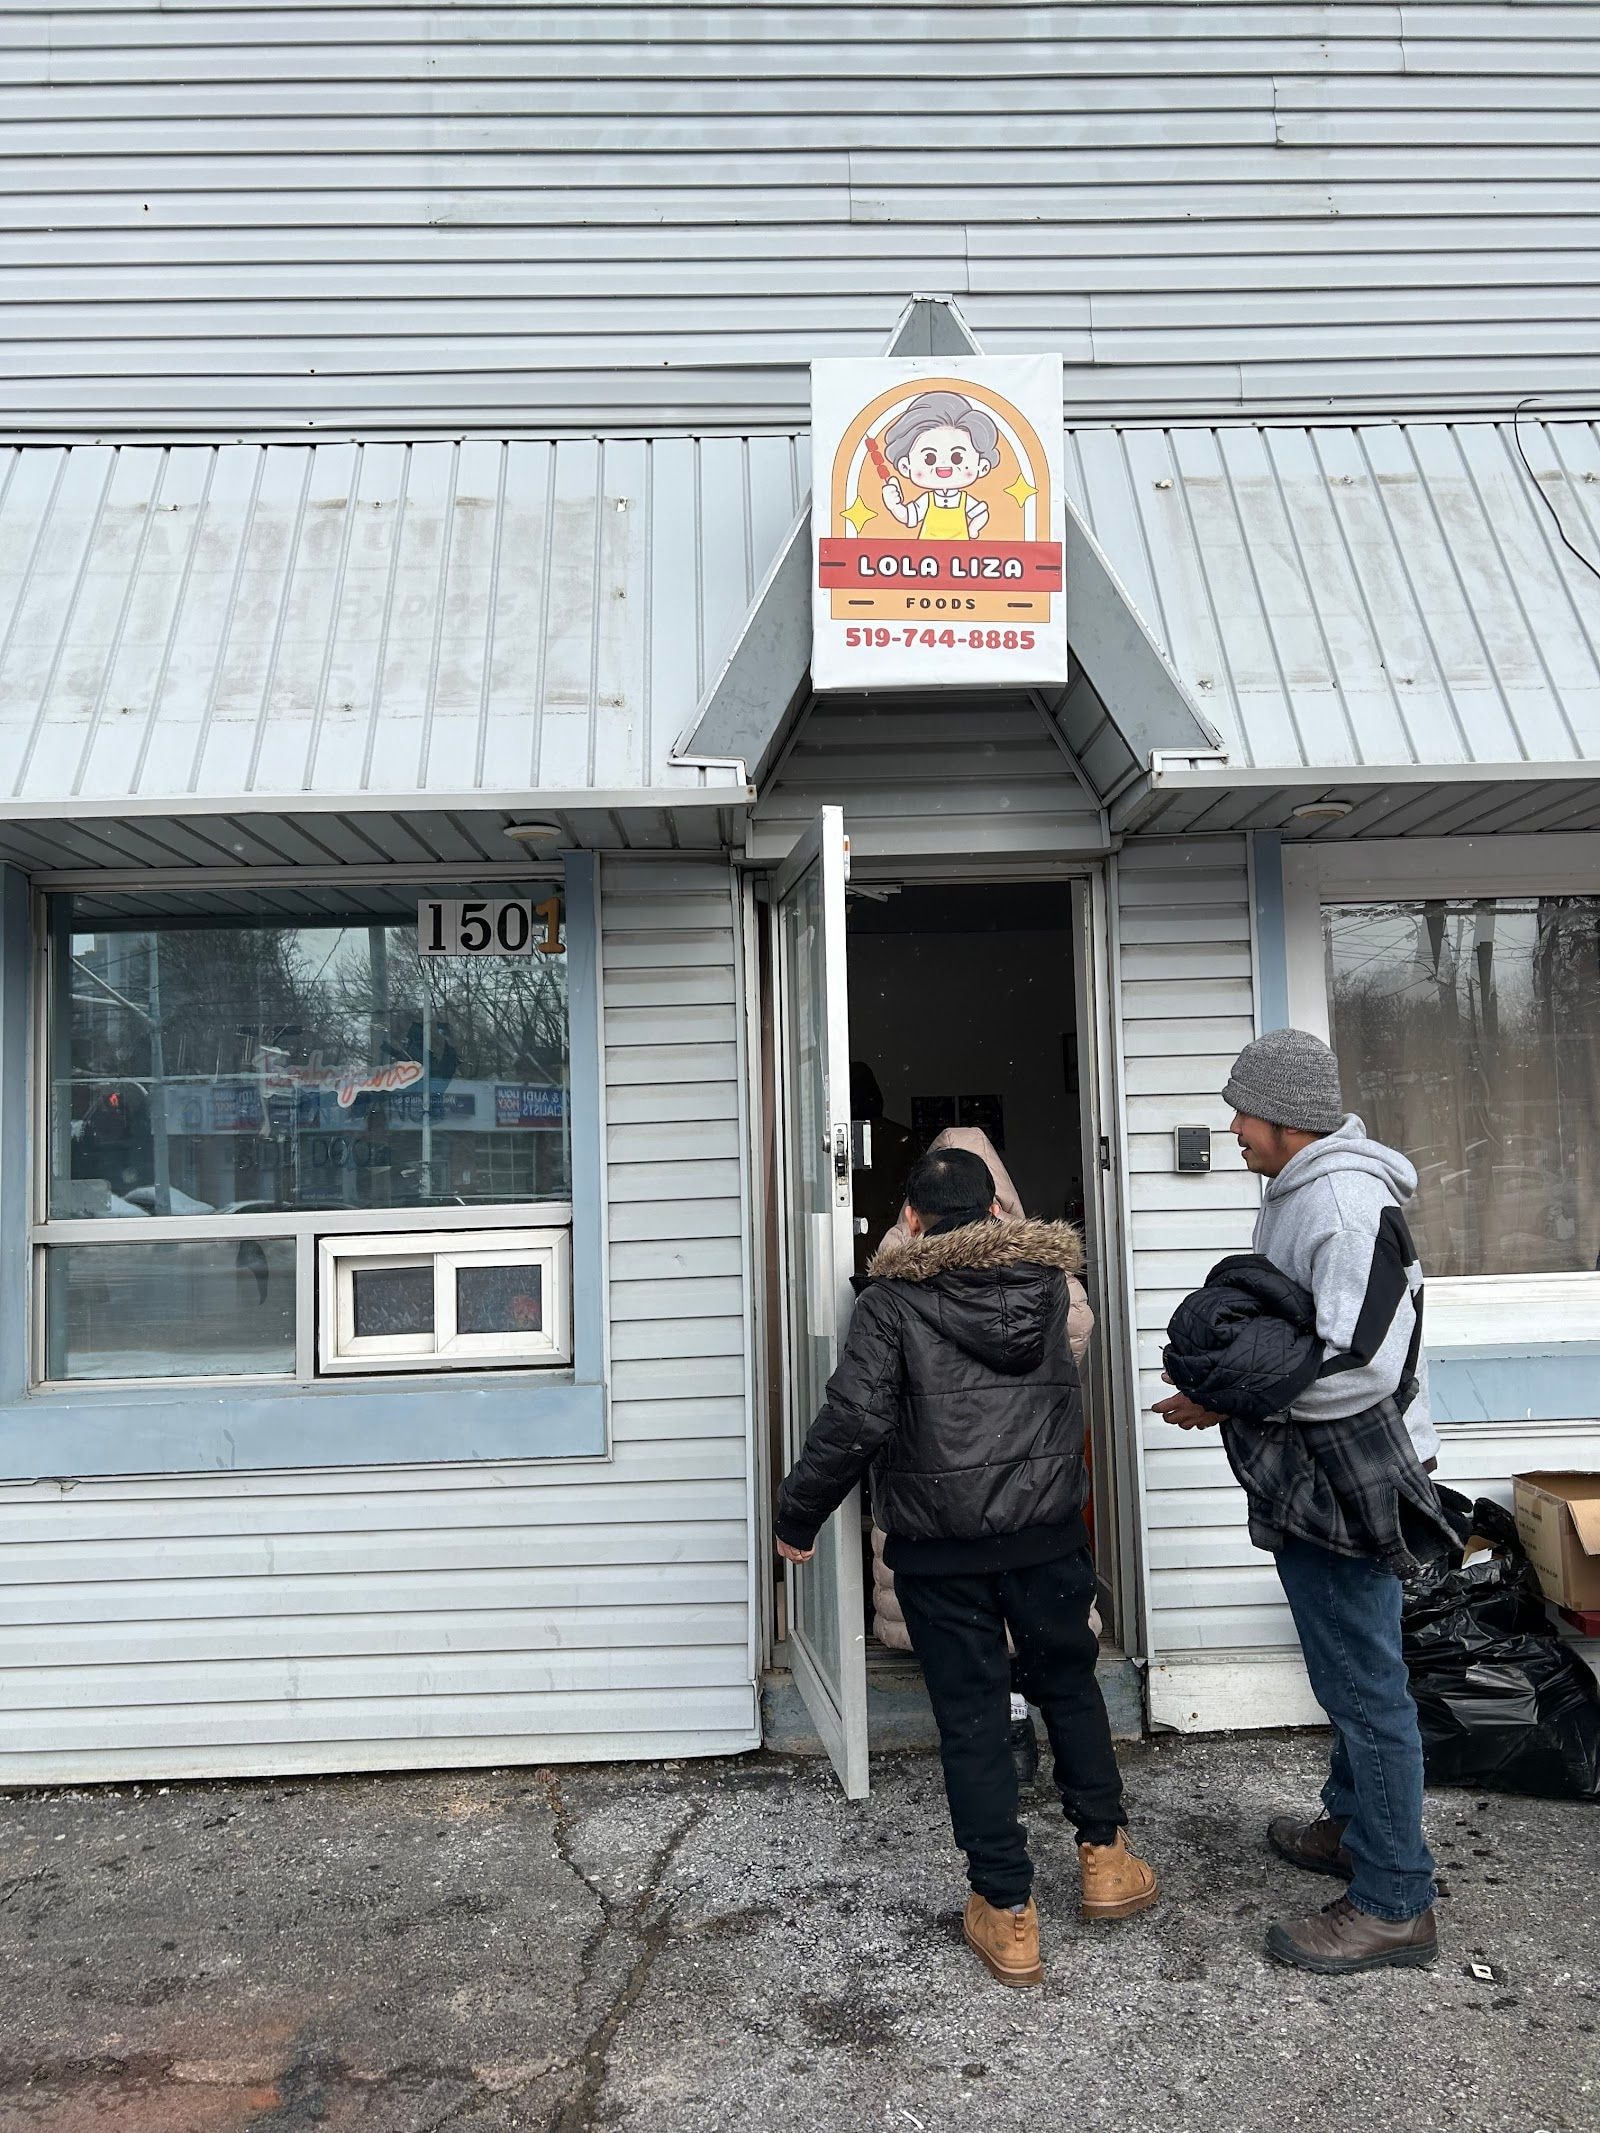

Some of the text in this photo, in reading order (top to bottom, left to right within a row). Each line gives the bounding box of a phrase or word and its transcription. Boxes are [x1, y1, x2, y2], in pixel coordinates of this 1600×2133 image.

[859, 554, 1024, 580] LOLA LIZA
[906, 597, 976, 610] FOODS
[845, 627, 1036, 650] 519-744-8885
[428, 897, 566, 954] 1501
